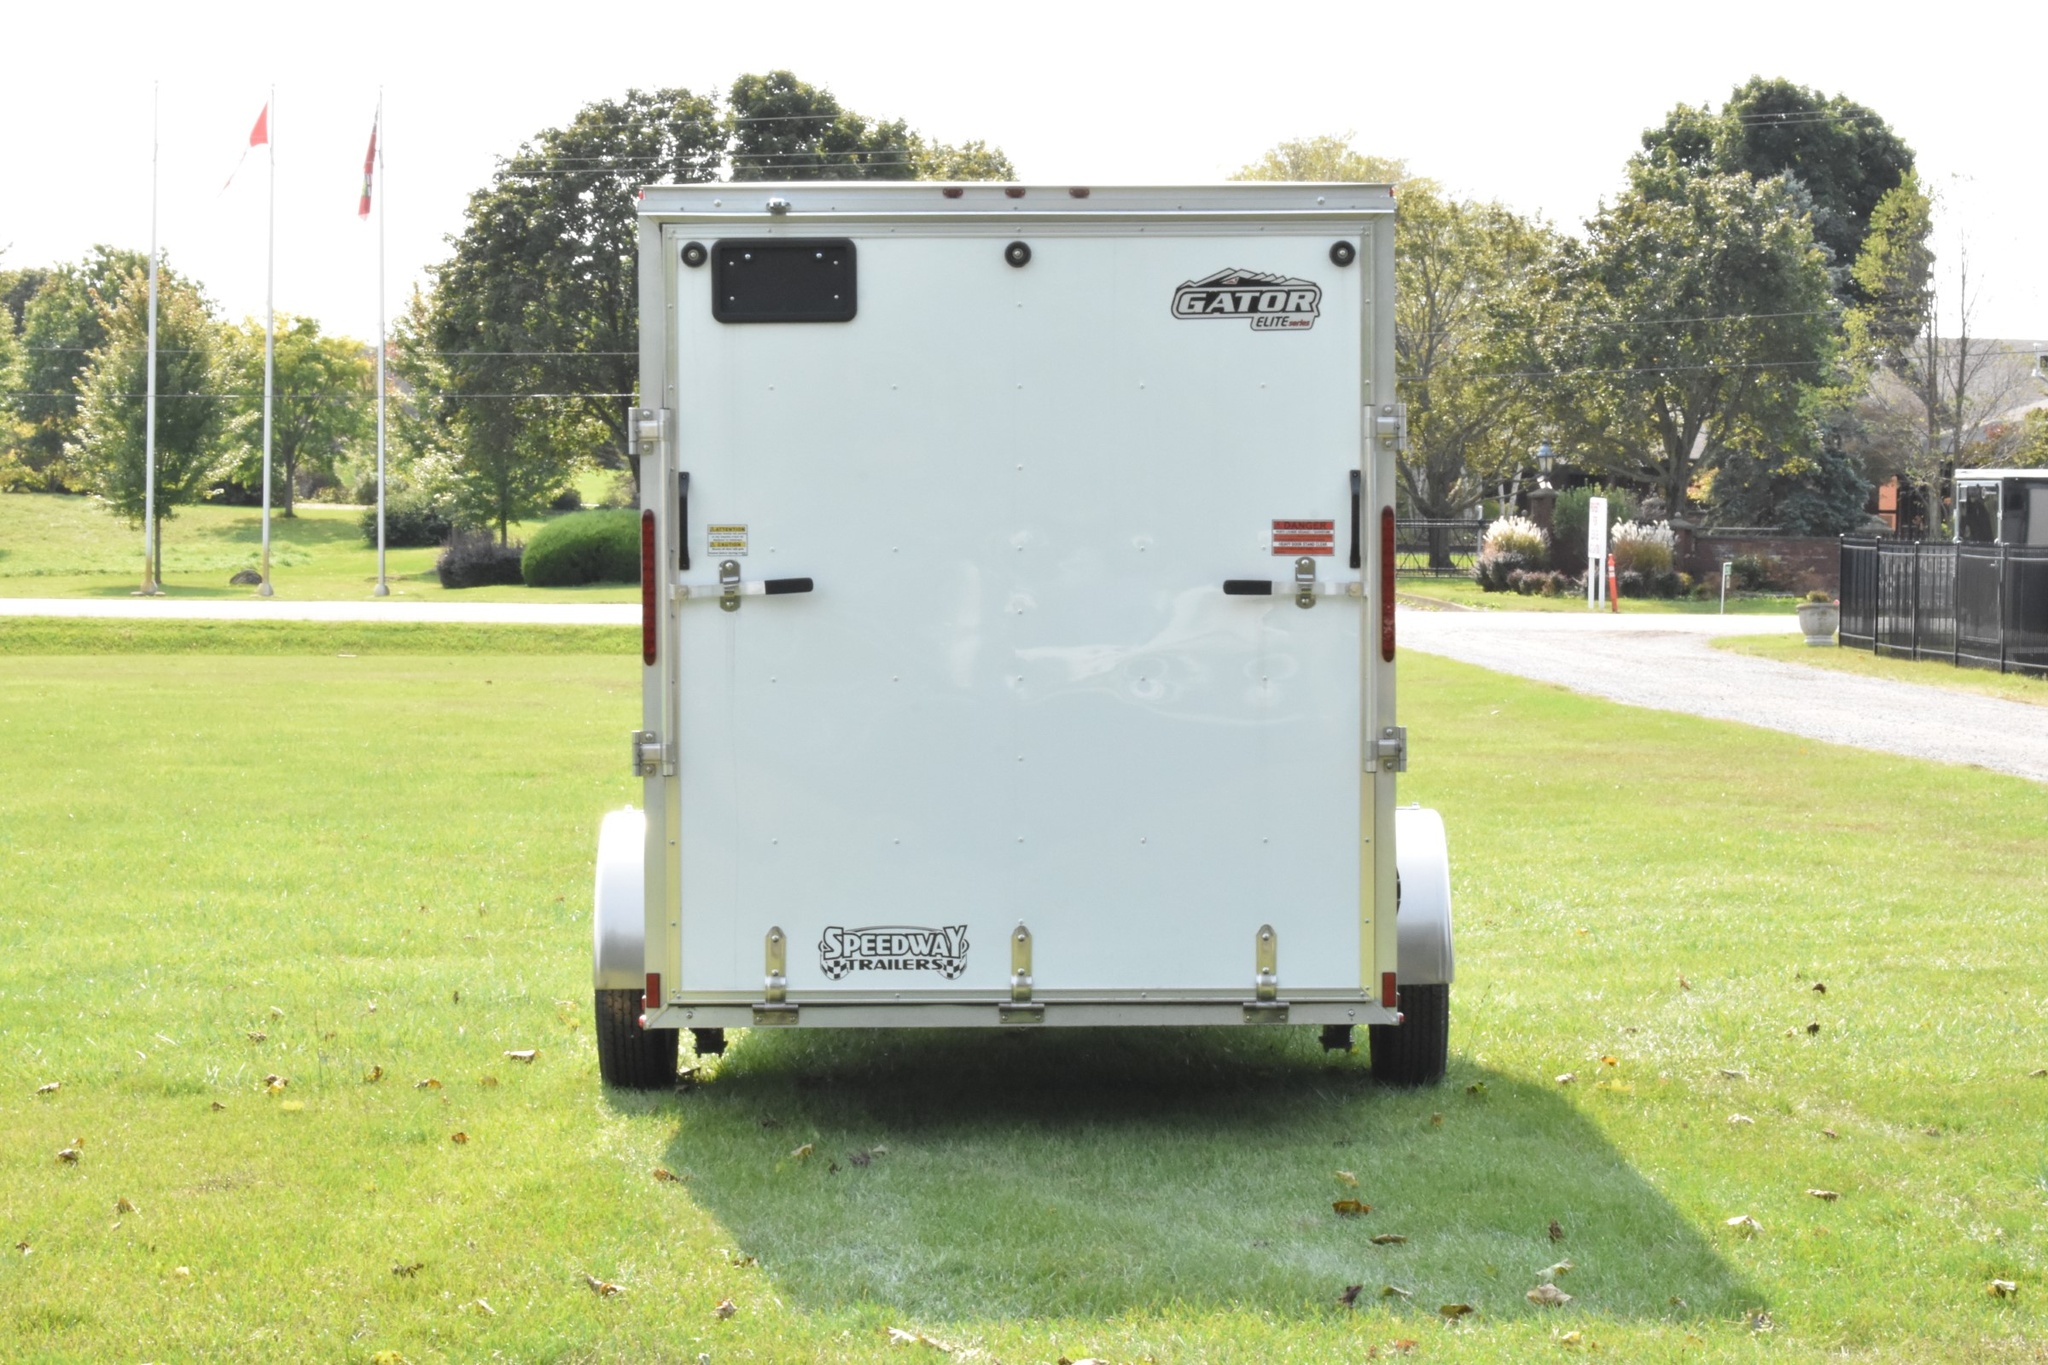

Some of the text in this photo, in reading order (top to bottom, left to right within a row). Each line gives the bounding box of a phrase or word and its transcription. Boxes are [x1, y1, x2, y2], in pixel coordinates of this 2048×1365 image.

[1177, 291, 1314, 313] GATOR
[1256, 316, 1289, 327] ELITE
[1284, 521, 1327, 529] DANGER
[823, 925, 967, 960] SPEEDWAY
[845, 959, 943, 970] TRAILERS
